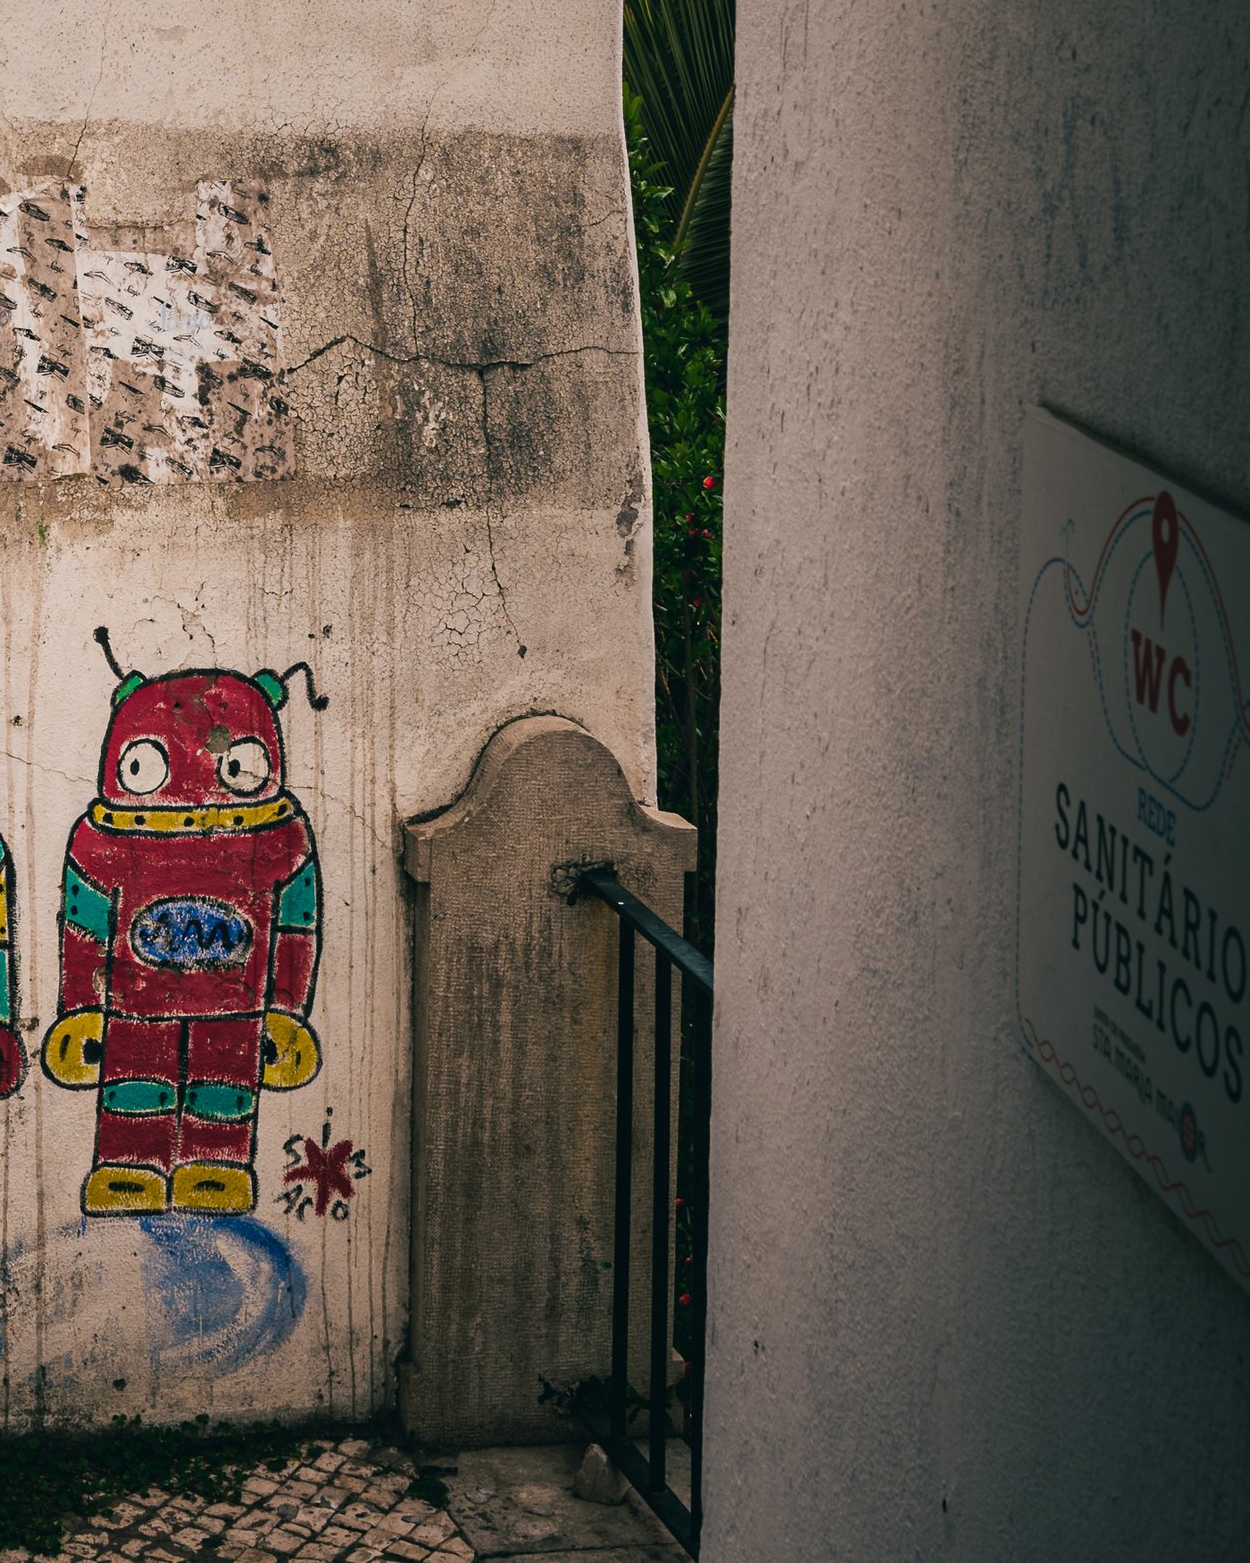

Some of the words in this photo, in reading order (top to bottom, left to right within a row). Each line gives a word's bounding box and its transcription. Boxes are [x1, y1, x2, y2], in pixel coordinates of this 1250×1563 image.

[1131, 628, 1192, 737] WC
[1138, 787, 1176, 847] REDE
[1071, 882, 1244, 1104] PÚBLICOS
